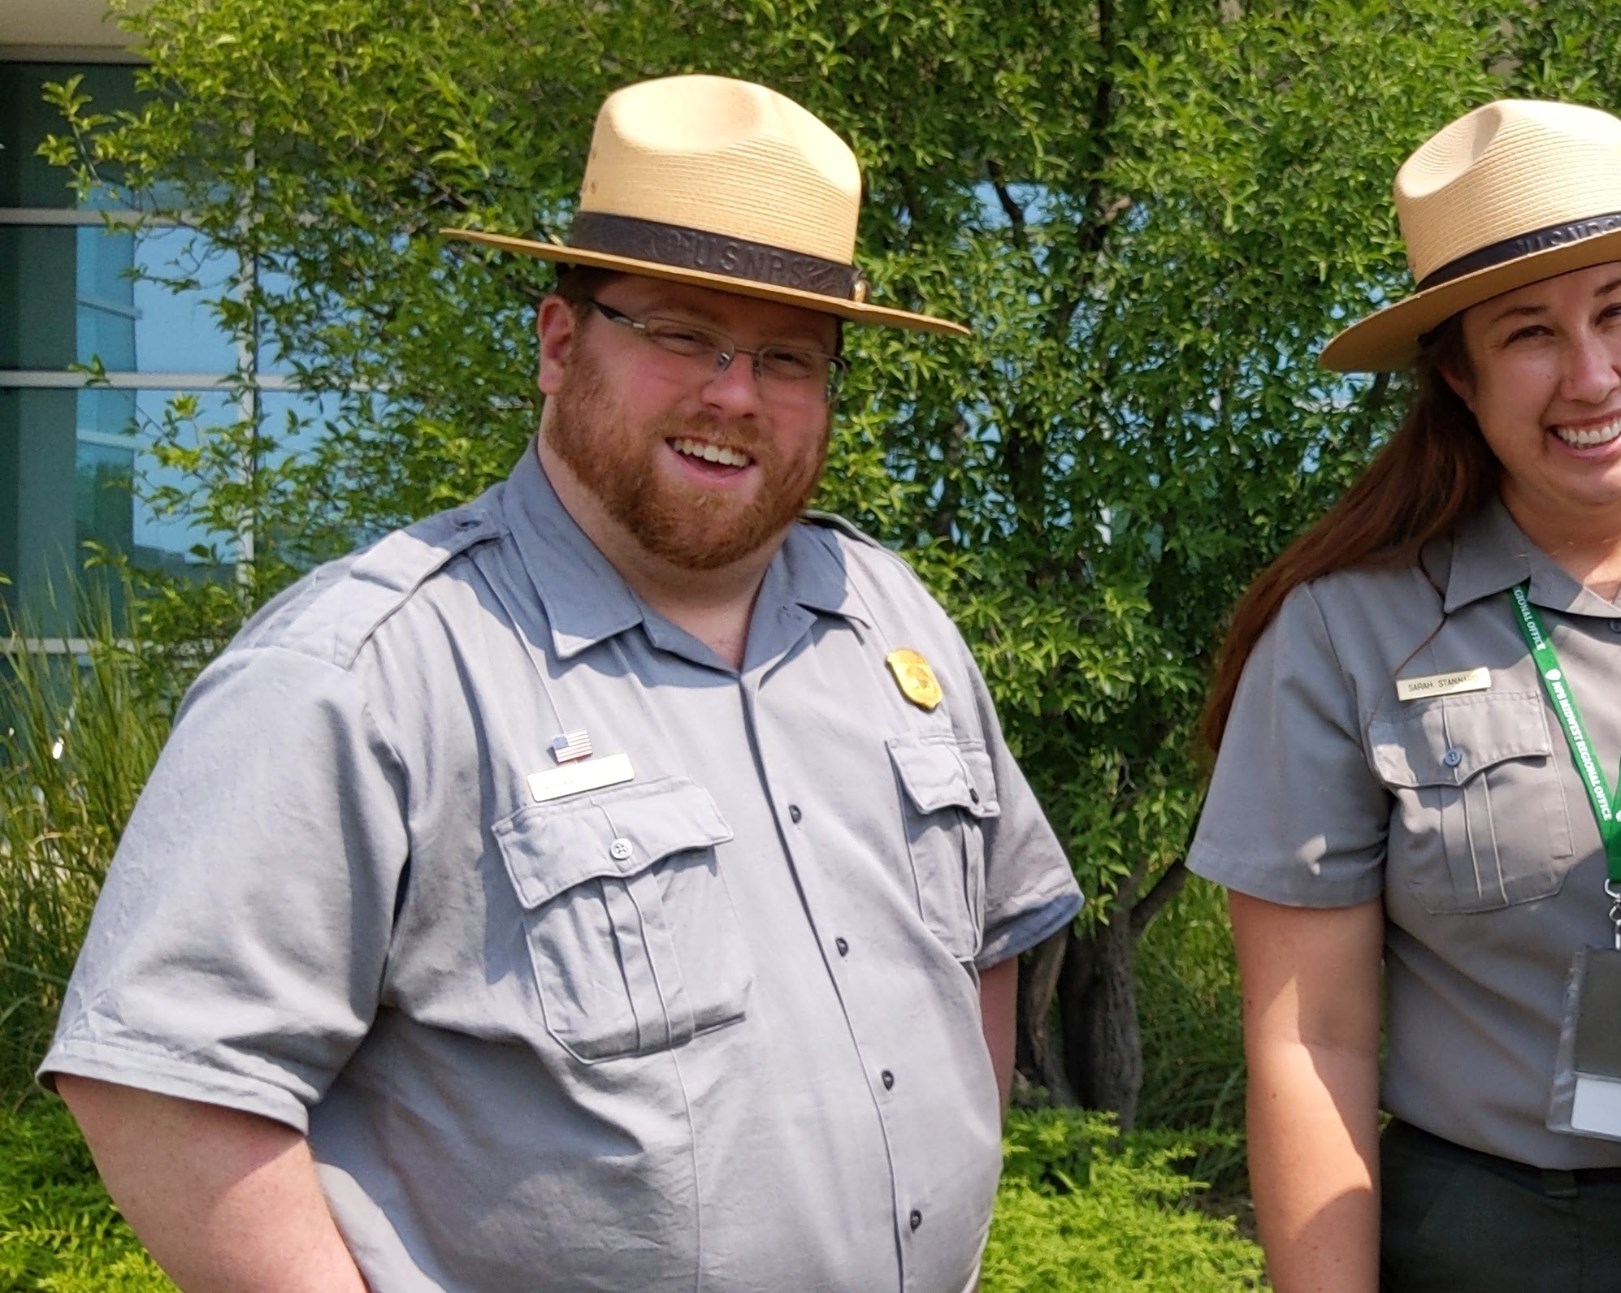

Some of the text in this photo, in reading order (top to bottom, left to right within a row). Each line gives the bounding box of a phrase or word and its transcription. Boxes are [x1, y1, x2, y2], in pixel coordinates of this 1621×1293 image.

[1512, 585, 1546, 651] GIONAL OFFICE
[1408, 674, 1480, 693] SARAH STANN
[1552, 681, 1612, 822] NPS MIDWEST REGIONAL OFFICE
